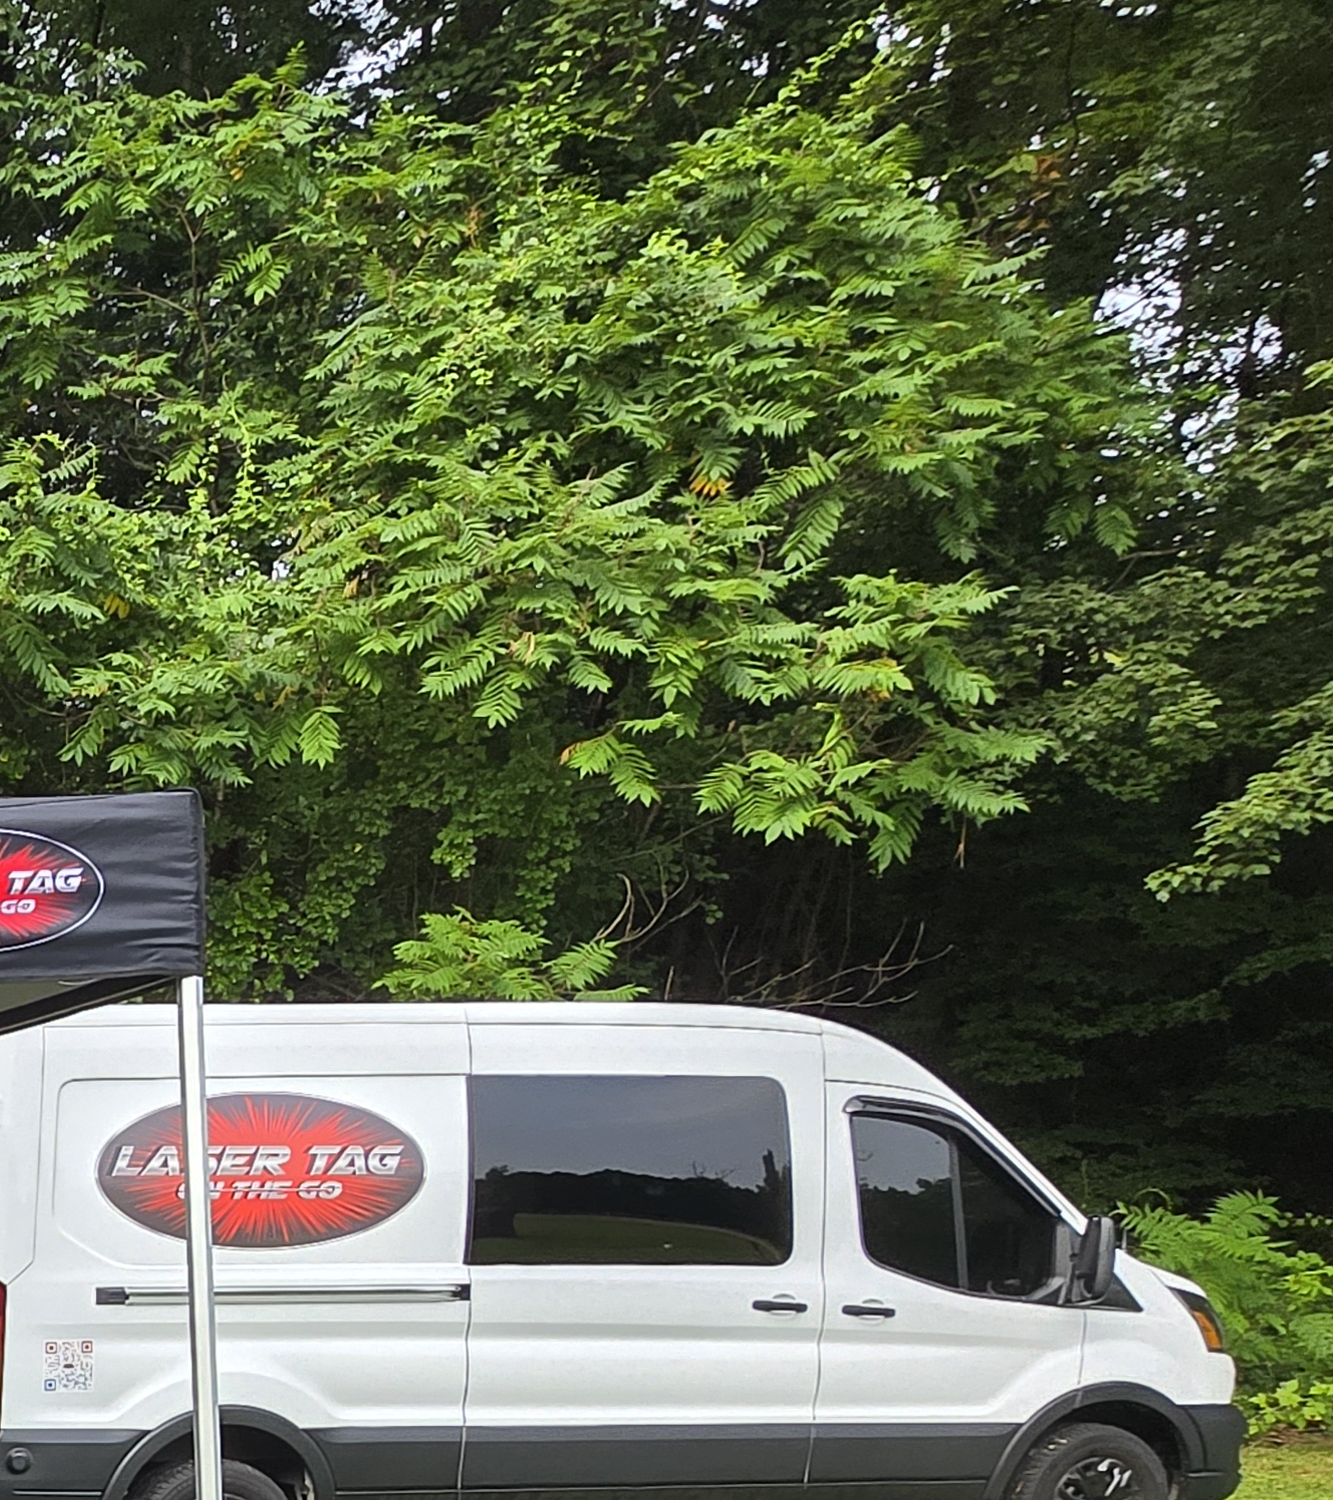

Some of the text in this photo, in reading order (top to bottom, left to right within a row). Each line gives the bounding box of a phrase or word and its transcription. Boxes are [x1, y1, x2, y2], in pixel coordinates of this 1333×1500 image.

[7, 867, 85, 895] TAG
[0, 898, 36, 916] GO
[307, 1145, 405, 1176] TAG
[232, 1181, 293, 1200] THE
[298, 1181, 344, 1199] GO
